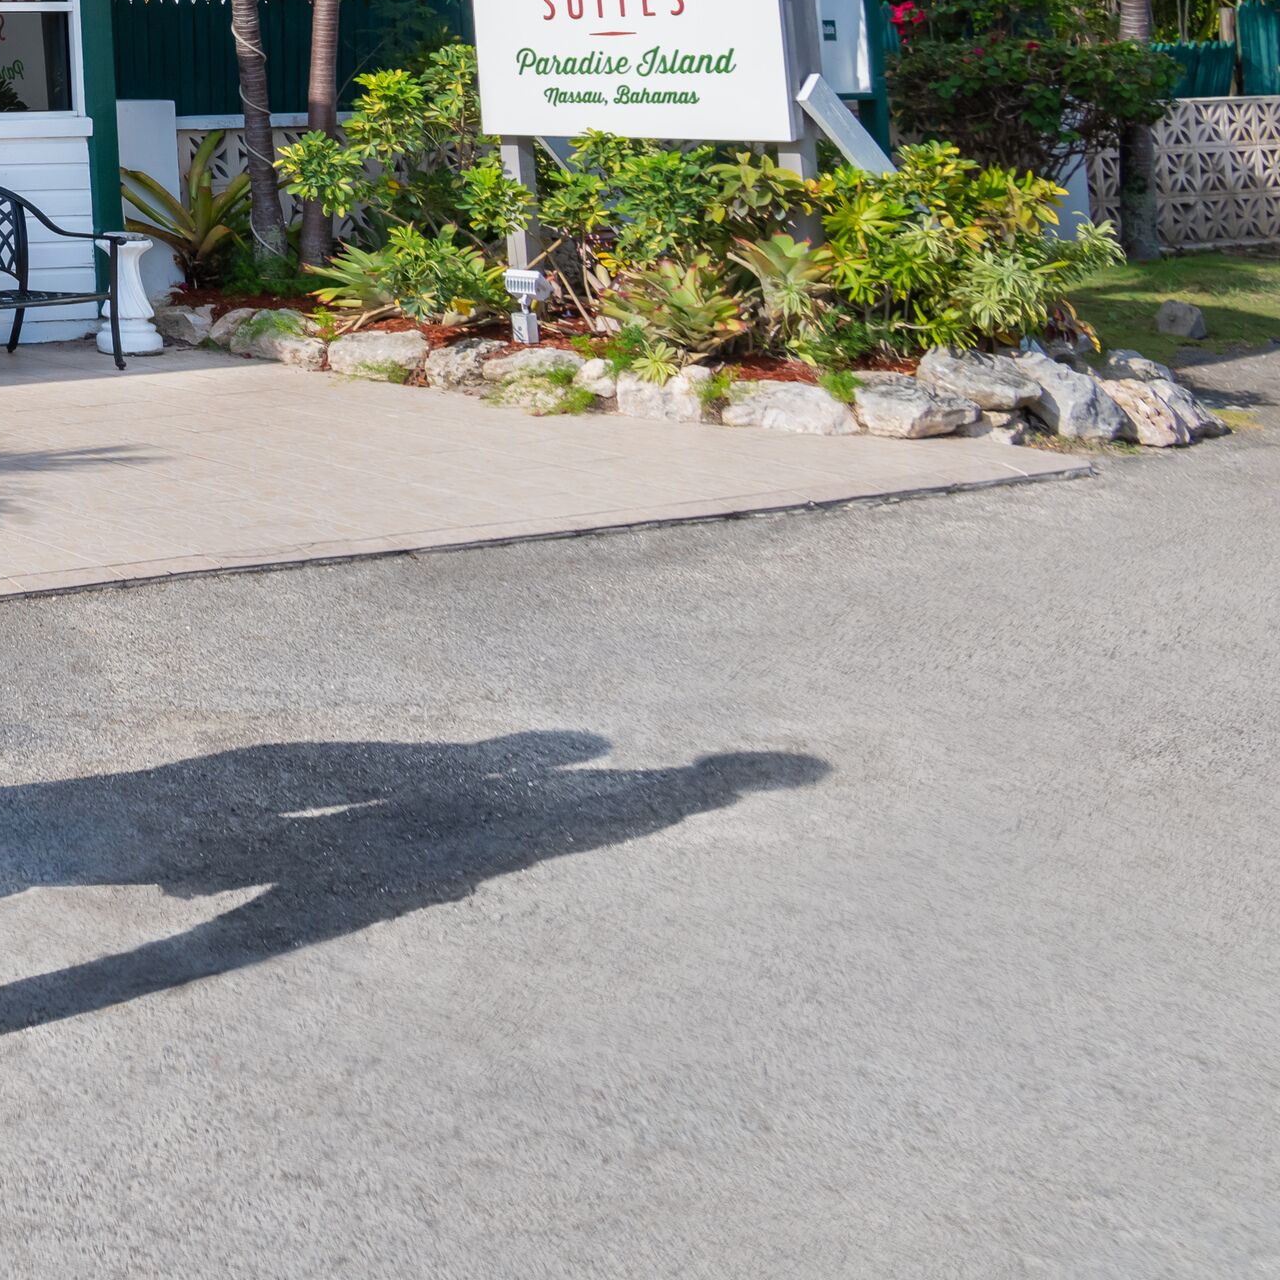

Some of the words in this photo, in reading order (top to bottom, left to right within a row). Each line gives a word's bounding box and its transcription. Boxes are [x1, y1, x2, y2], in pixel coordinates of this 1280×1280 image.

[516, 47, 631, 76] Paradise
[636, 45, 737, 77] Island
[544, 86, 608, 107] Nassau,
[613, 85, 700, 105] Bahamas
